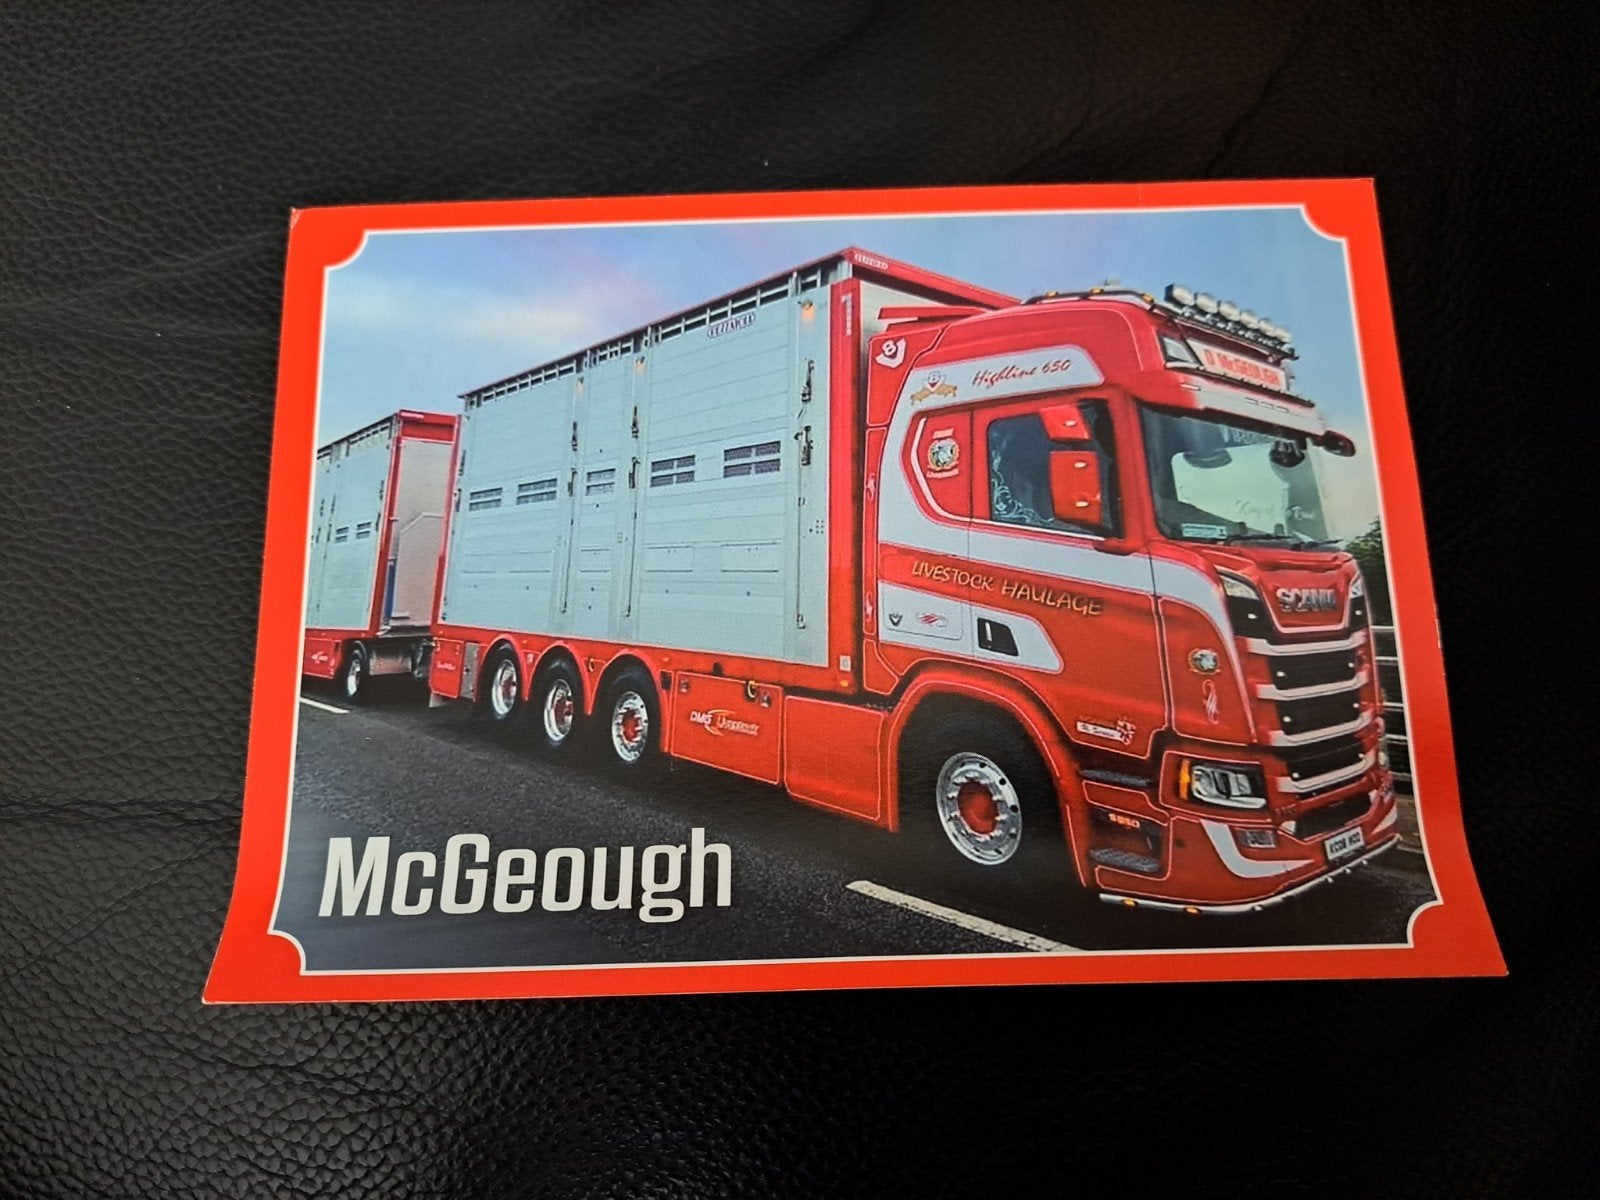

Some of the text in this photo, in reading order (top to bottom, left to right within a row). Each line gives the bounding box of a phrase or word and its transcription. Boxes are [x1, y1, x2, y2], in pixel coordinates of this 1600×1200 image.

[972, 359, 1073, 389] Highline 650
[912, 560, 1103, 616] LIVESTOCK HAULAGE
[318, 827, 732, 923] McGeough
